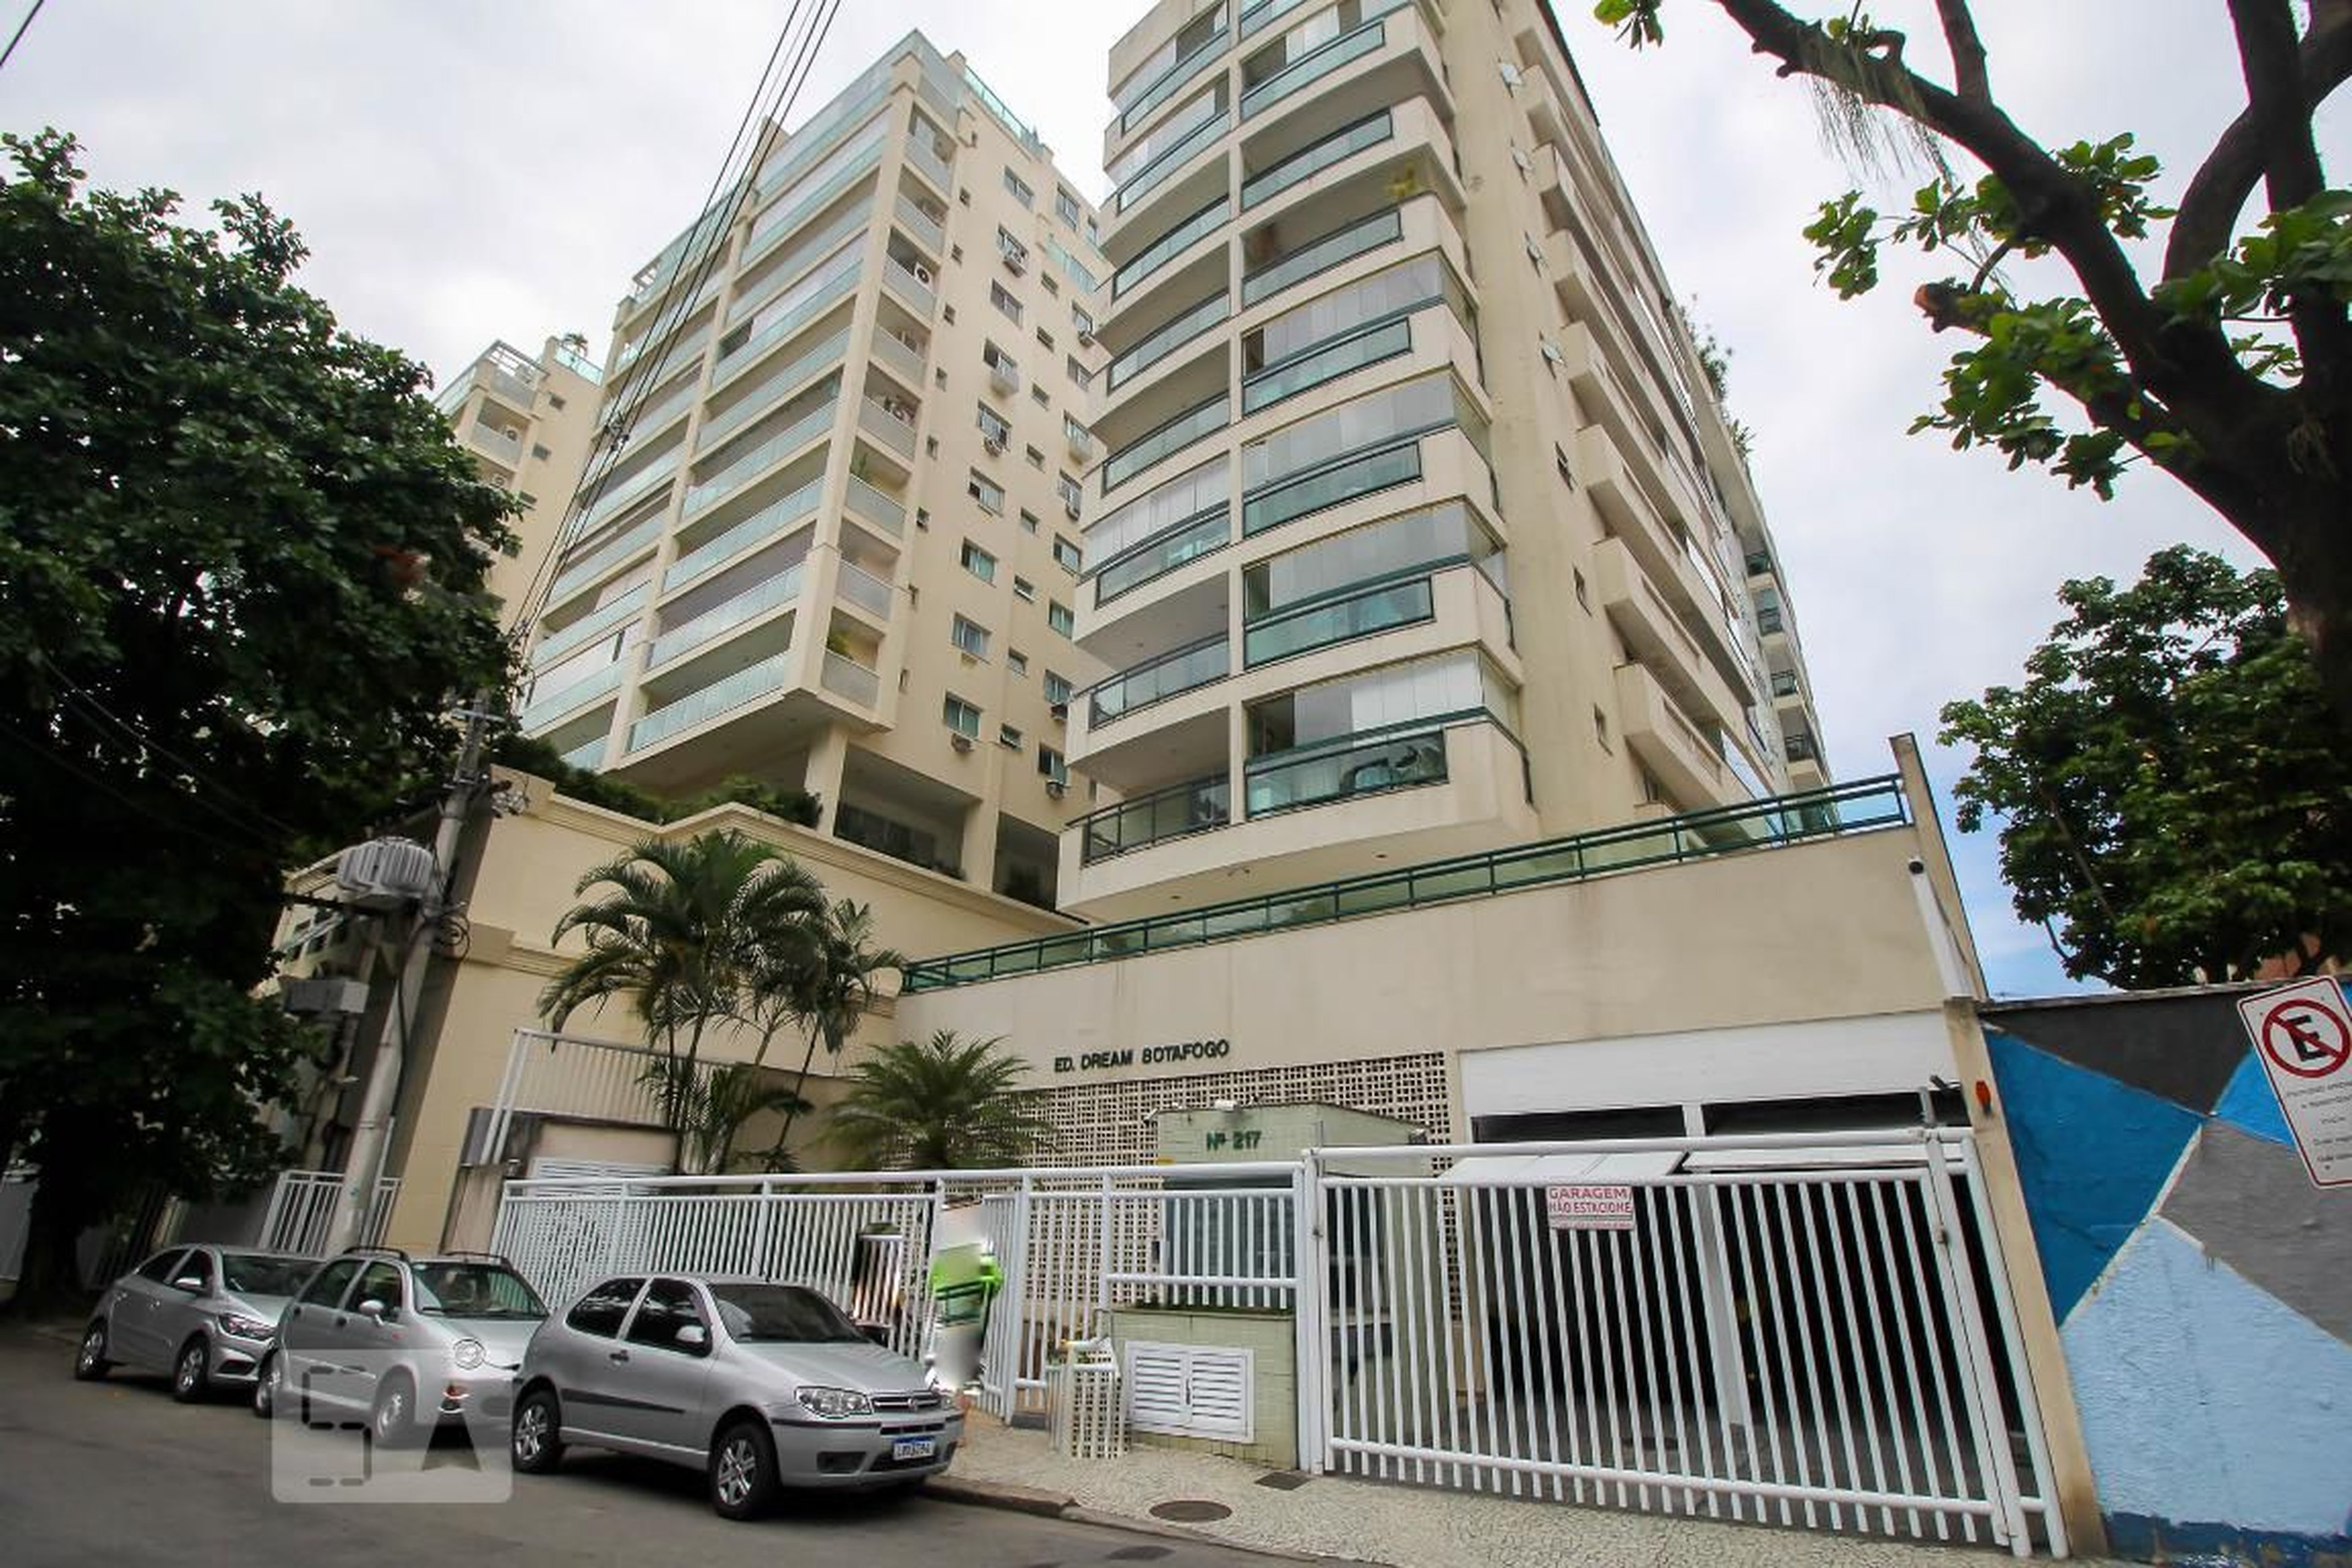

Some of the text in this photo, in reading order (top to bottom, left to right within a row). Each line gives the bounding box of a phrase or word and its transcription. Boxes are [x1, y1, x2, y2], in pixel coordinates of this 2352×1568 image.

[1054, 1039, 1229, 1072] ED. DREAM BOTAFOGO
[1232, 1131, 1262, 1150] 217
[1549, 1188, 1627, 1199] GARAGEM
[1574, 1202, 1632, 1213] ESTACIONE
